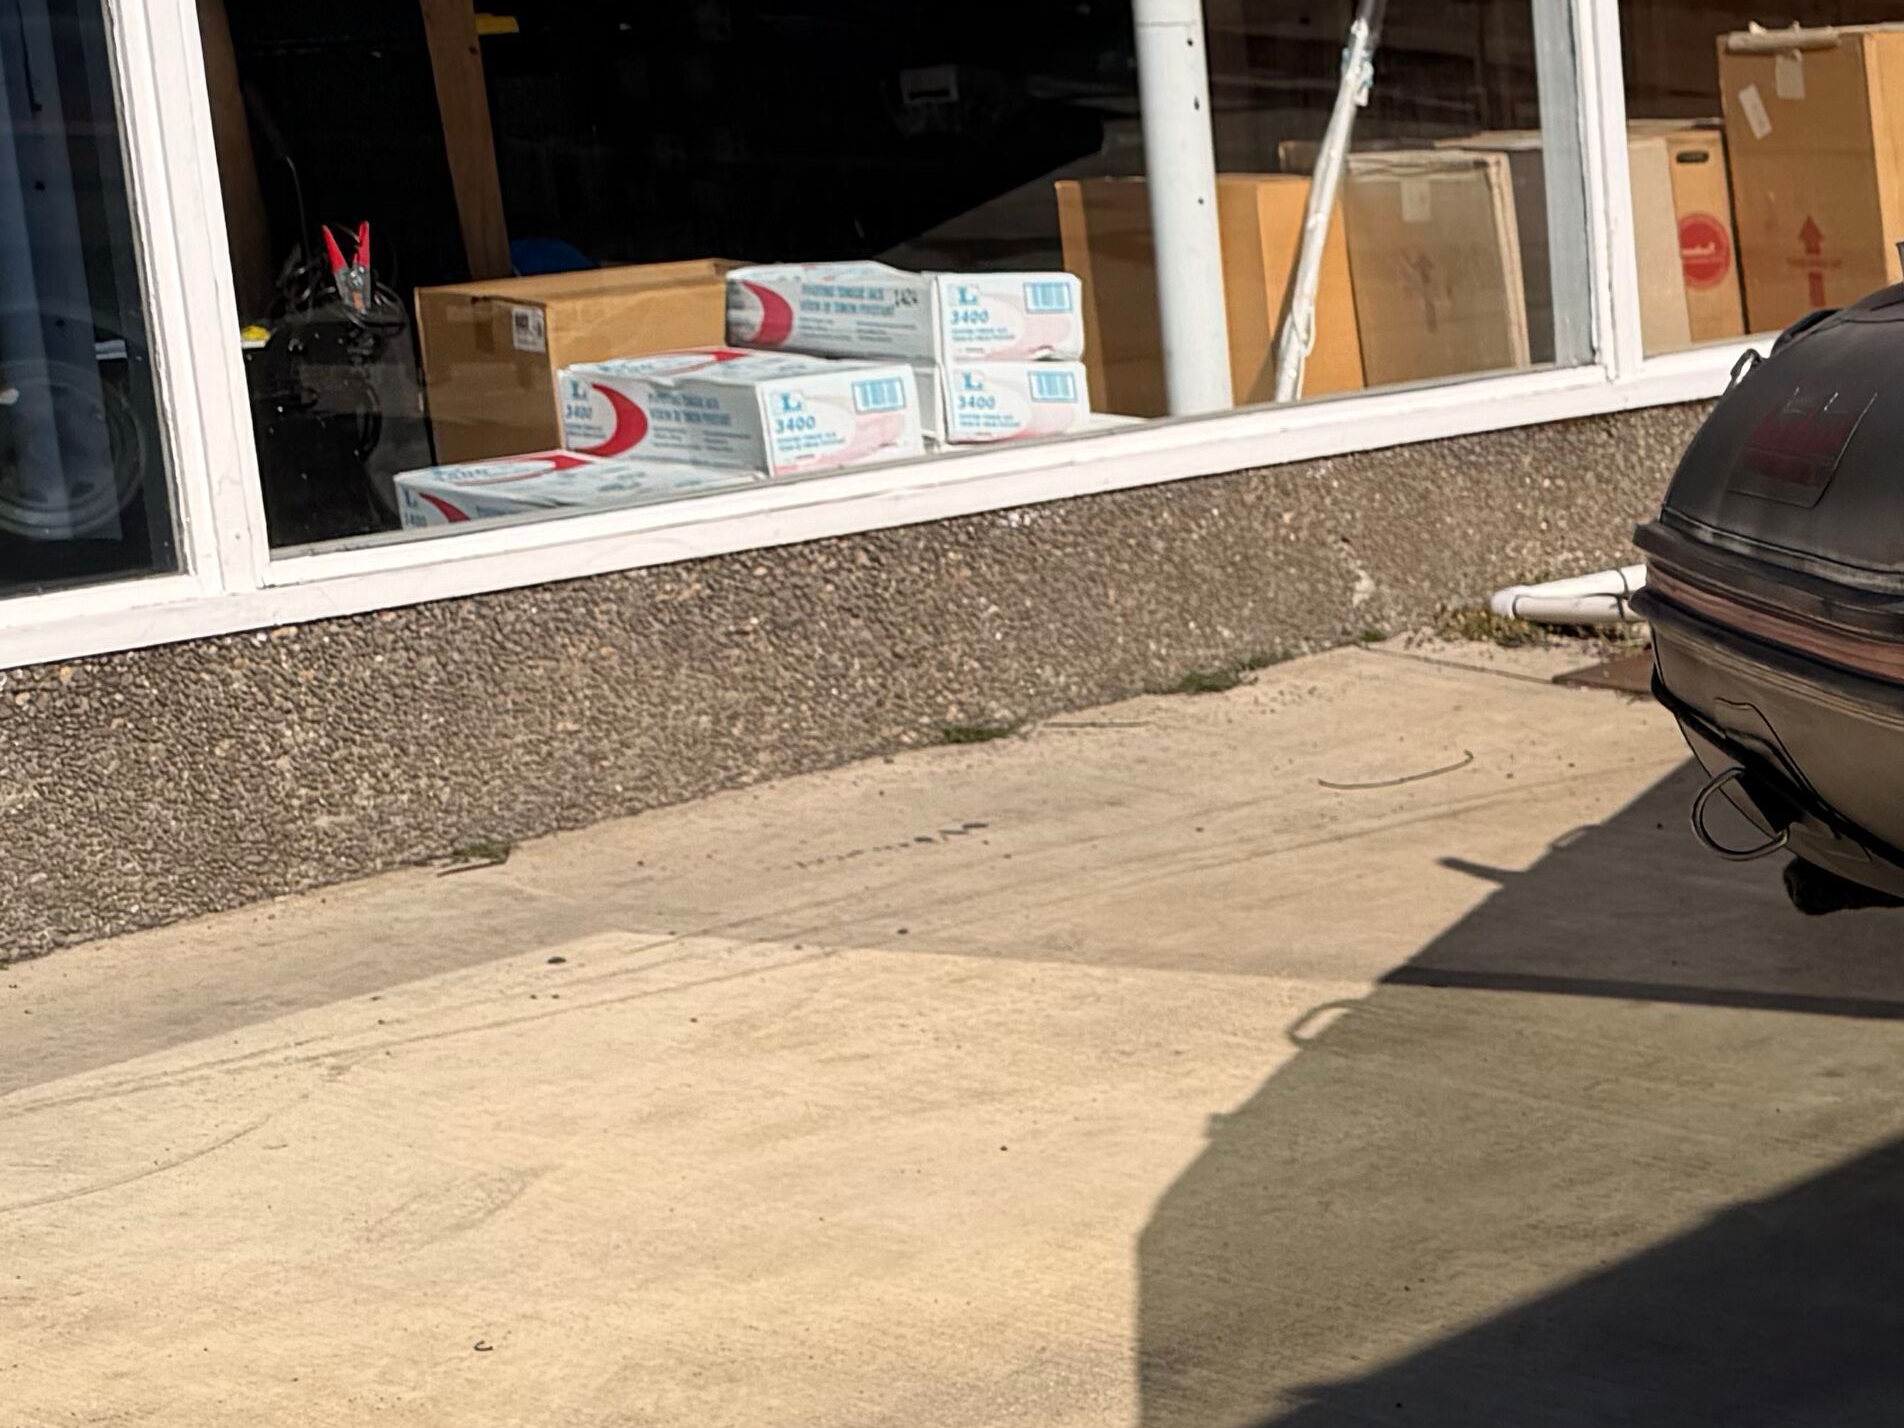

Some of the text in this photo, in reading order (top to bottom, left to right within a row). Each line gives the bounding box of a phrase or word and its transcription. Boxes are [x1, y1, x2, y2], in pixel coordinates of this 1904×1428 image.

[950, 309, 989, 325] 3400
[957, 395, 995, 410] 3400
[775, 415, 816, 435] 3400
